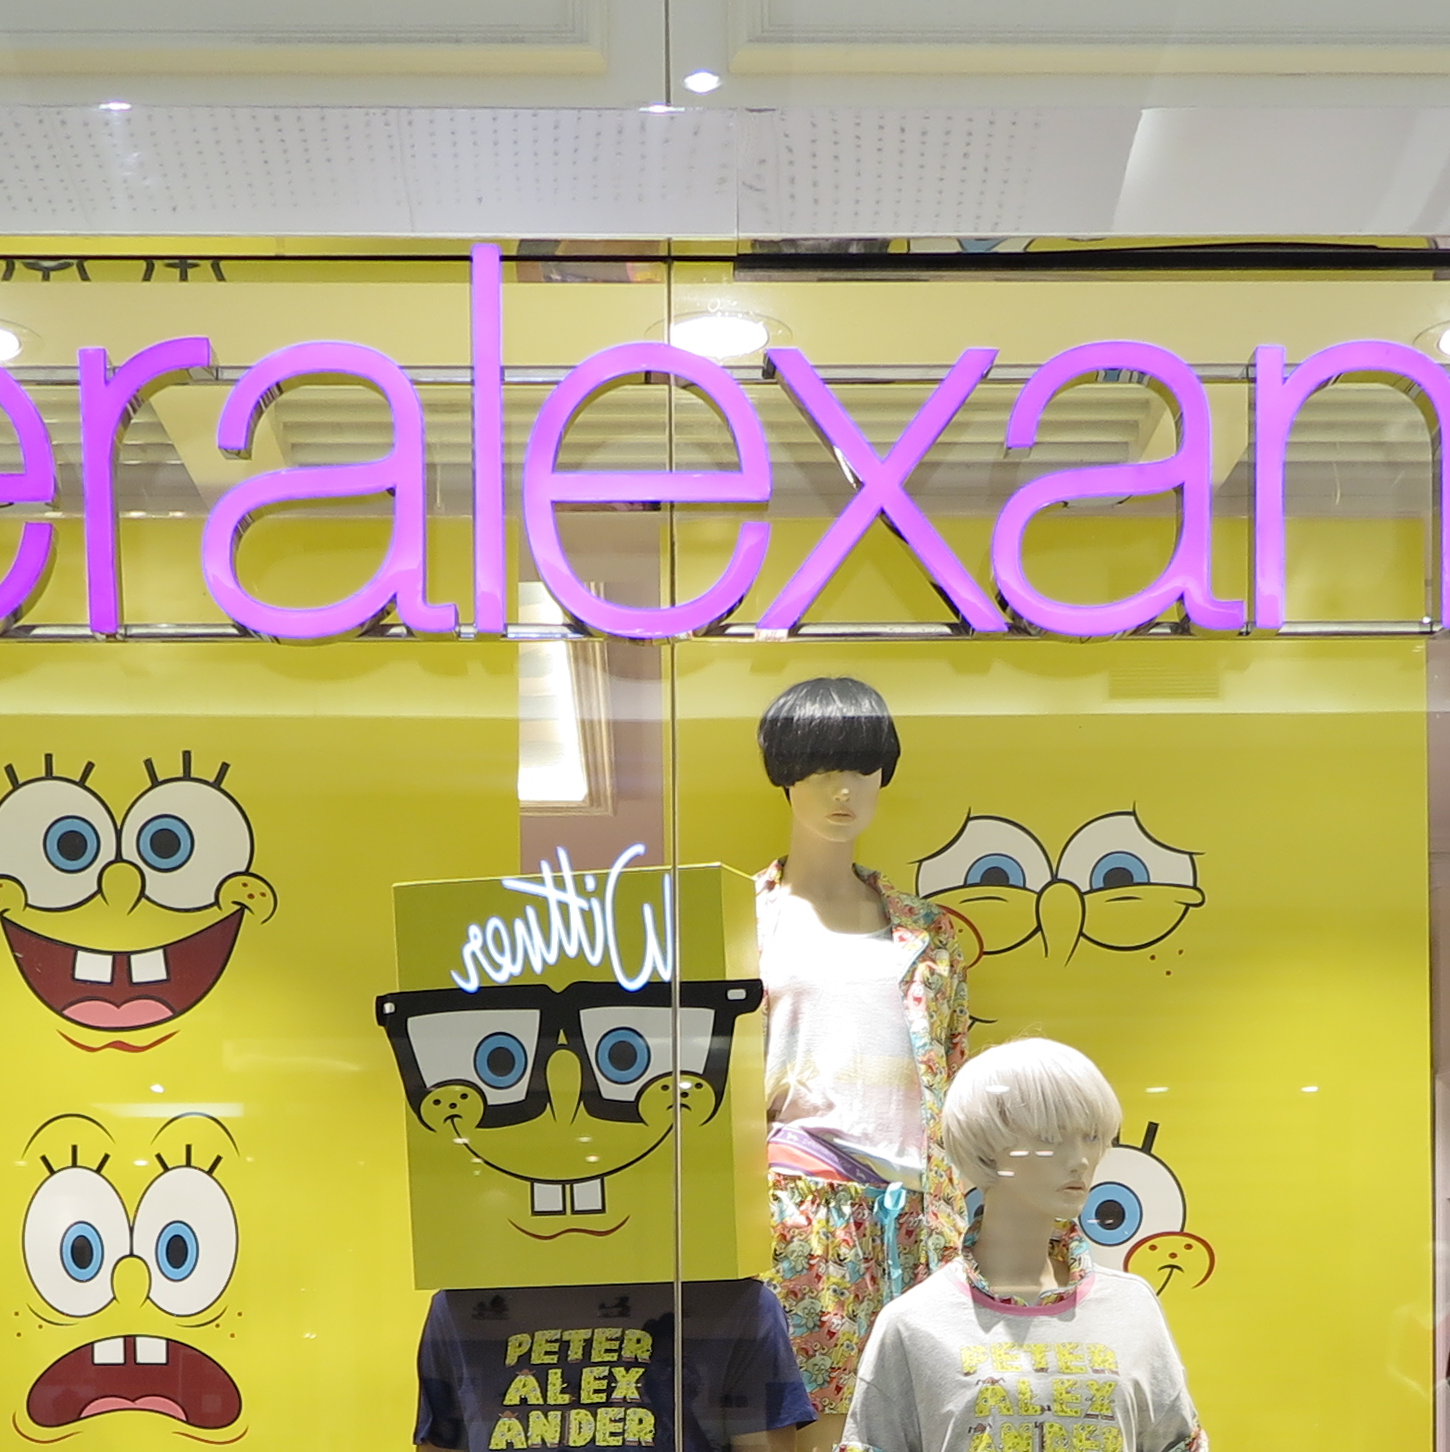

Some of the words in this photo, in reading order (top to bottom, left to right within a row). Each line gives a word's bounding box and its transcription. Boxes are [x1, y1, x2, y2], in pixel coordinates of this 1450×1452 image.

[504, 1326, 654, 1368] PETER
[960, 1341, 1120, 1377] PETER
[502, 1365, 646, 1406] ALEX
[974, 1377, 1117, 1422] ALEX
[488, 1406, 657, 1451] ANDER
